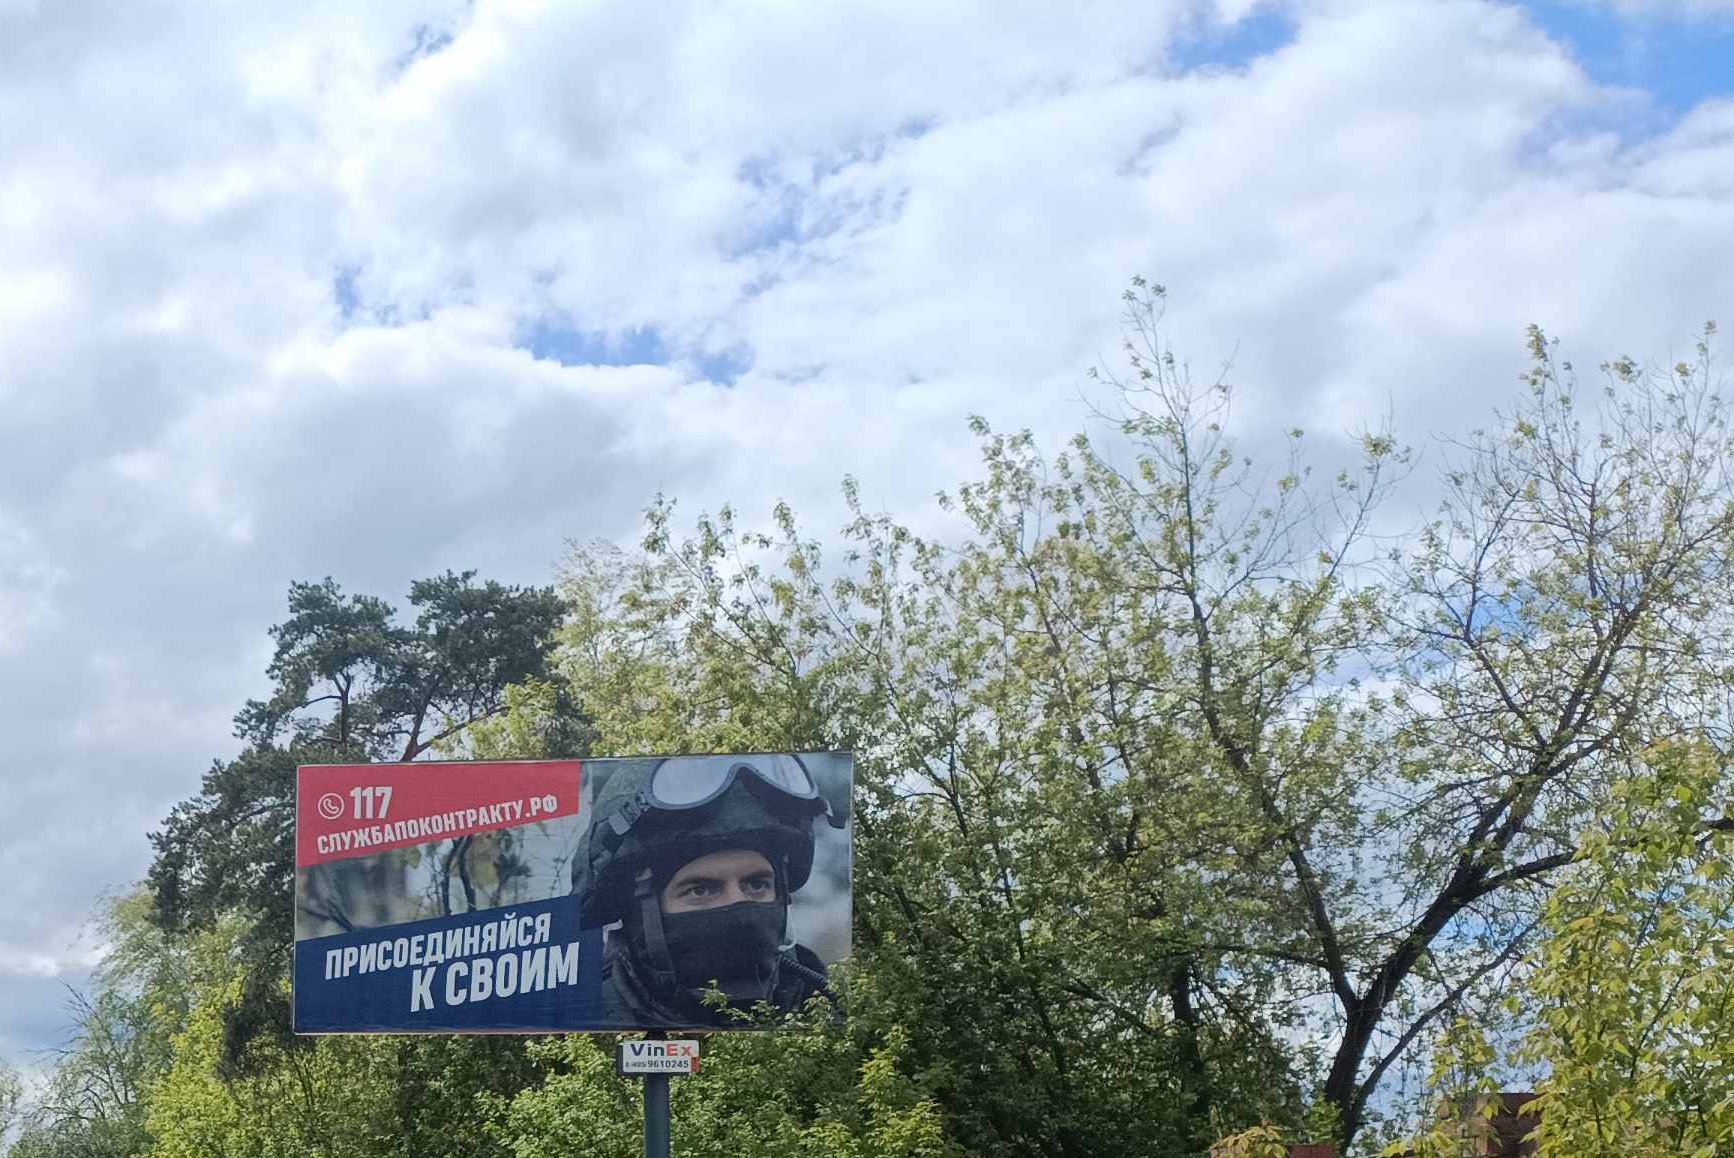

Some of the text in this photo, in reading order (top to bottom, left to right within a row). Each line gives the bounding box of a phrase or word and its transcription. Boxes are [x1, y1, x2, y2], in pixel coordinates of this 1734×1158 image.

[317, 794, 558, 854] СЛУЖБАПОКОНТРАКТУ.РФ
[350, 786, 392, 819] 117
[325, 912, 551, 980] ПРИСОЕДИНЯЙСЯ
[410, 941, 579, 1012] К СВОИМ
[630, 1043, 692, 1056] VinEx
